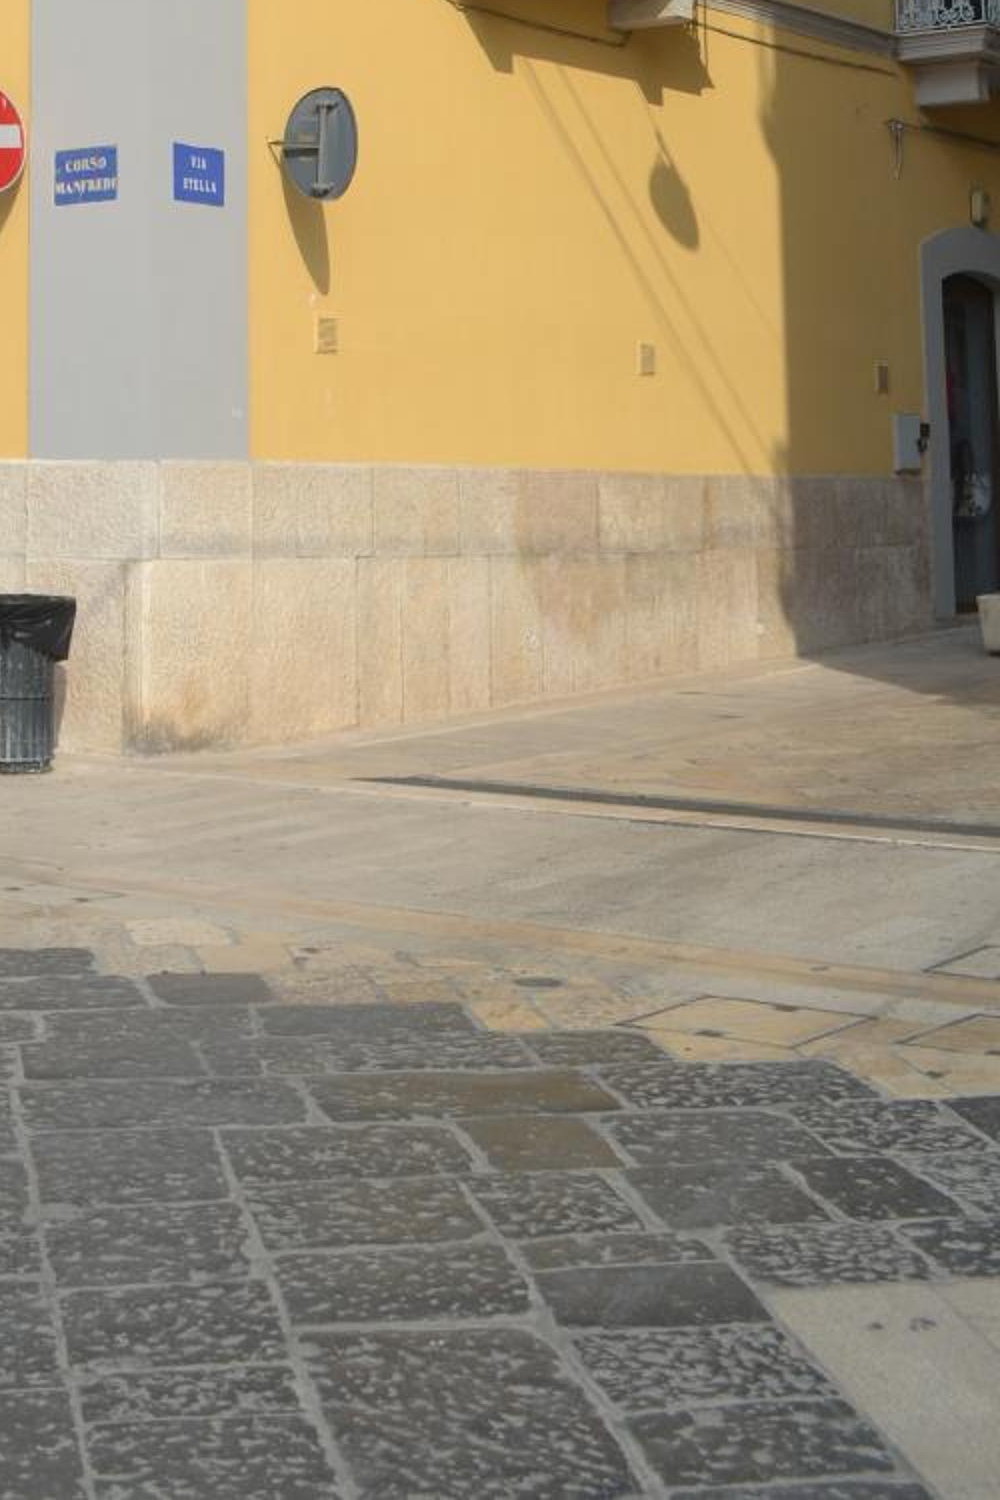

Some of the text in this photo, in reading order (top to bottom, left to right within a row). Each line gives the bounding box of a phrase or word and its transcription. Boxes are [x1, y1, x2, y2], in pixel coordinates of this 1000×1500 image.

[65, 156, 106, 173] CORSO
[190, 155, 206, 169] VIA
[183, 177, 216, 193] STELLA
